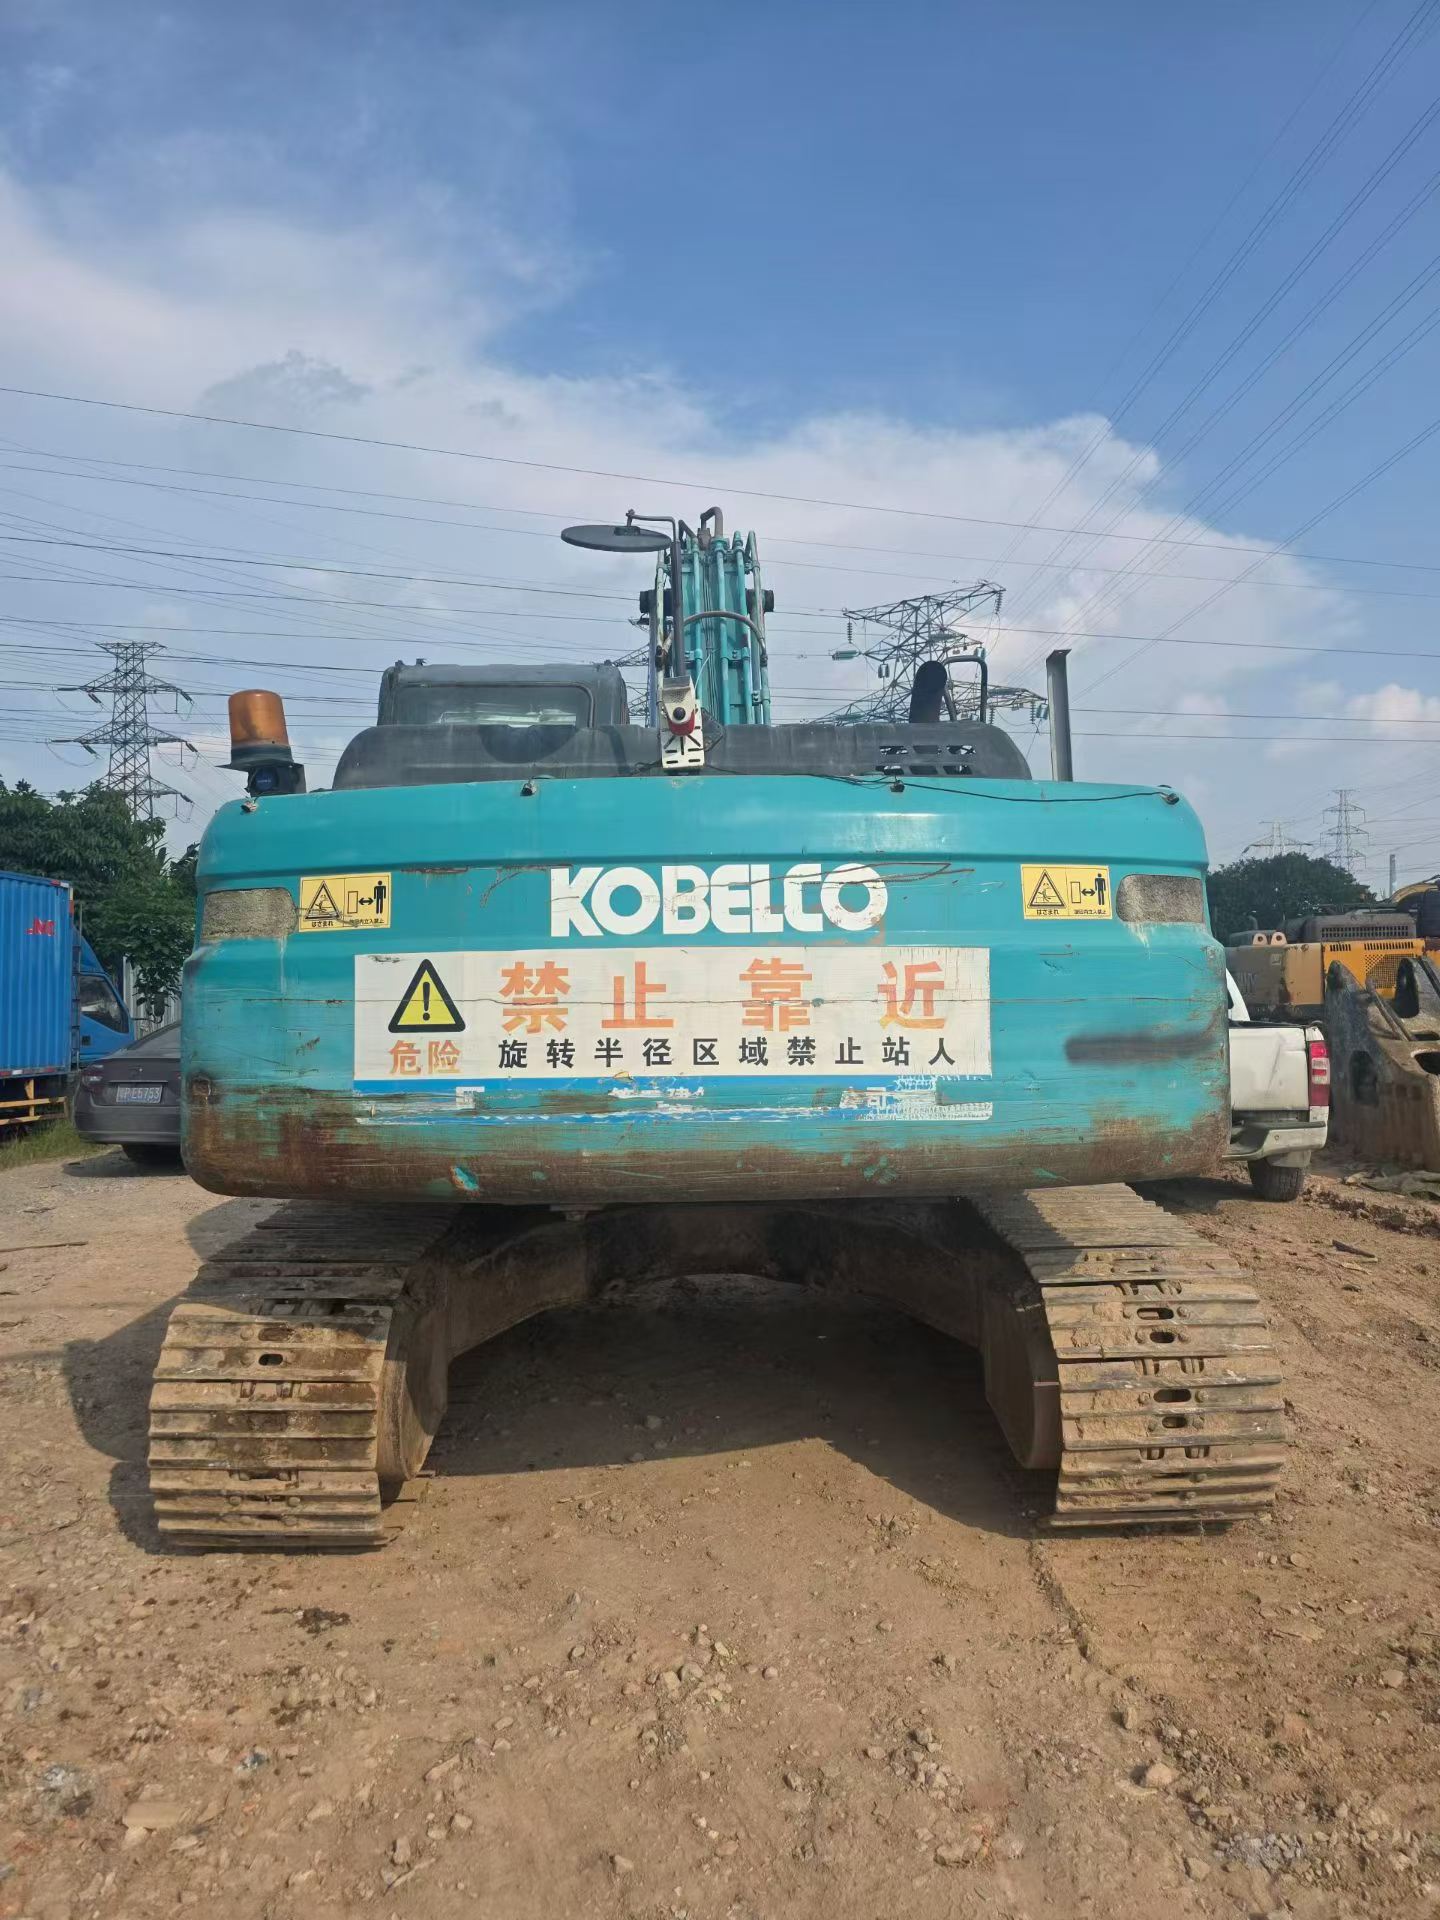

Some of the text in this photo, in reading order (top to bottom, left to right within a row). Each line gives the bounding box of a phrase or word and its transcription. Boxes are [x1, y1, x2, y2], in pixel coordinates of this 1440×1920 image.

[550, 863, 889, 937] KOBELCO
[498, 957, 945, 1034] 禁止靠近
[389, 1040, 462, 1075] 危险
[498, 1036, 956, 1069] 旋转半径区域禁止站人
